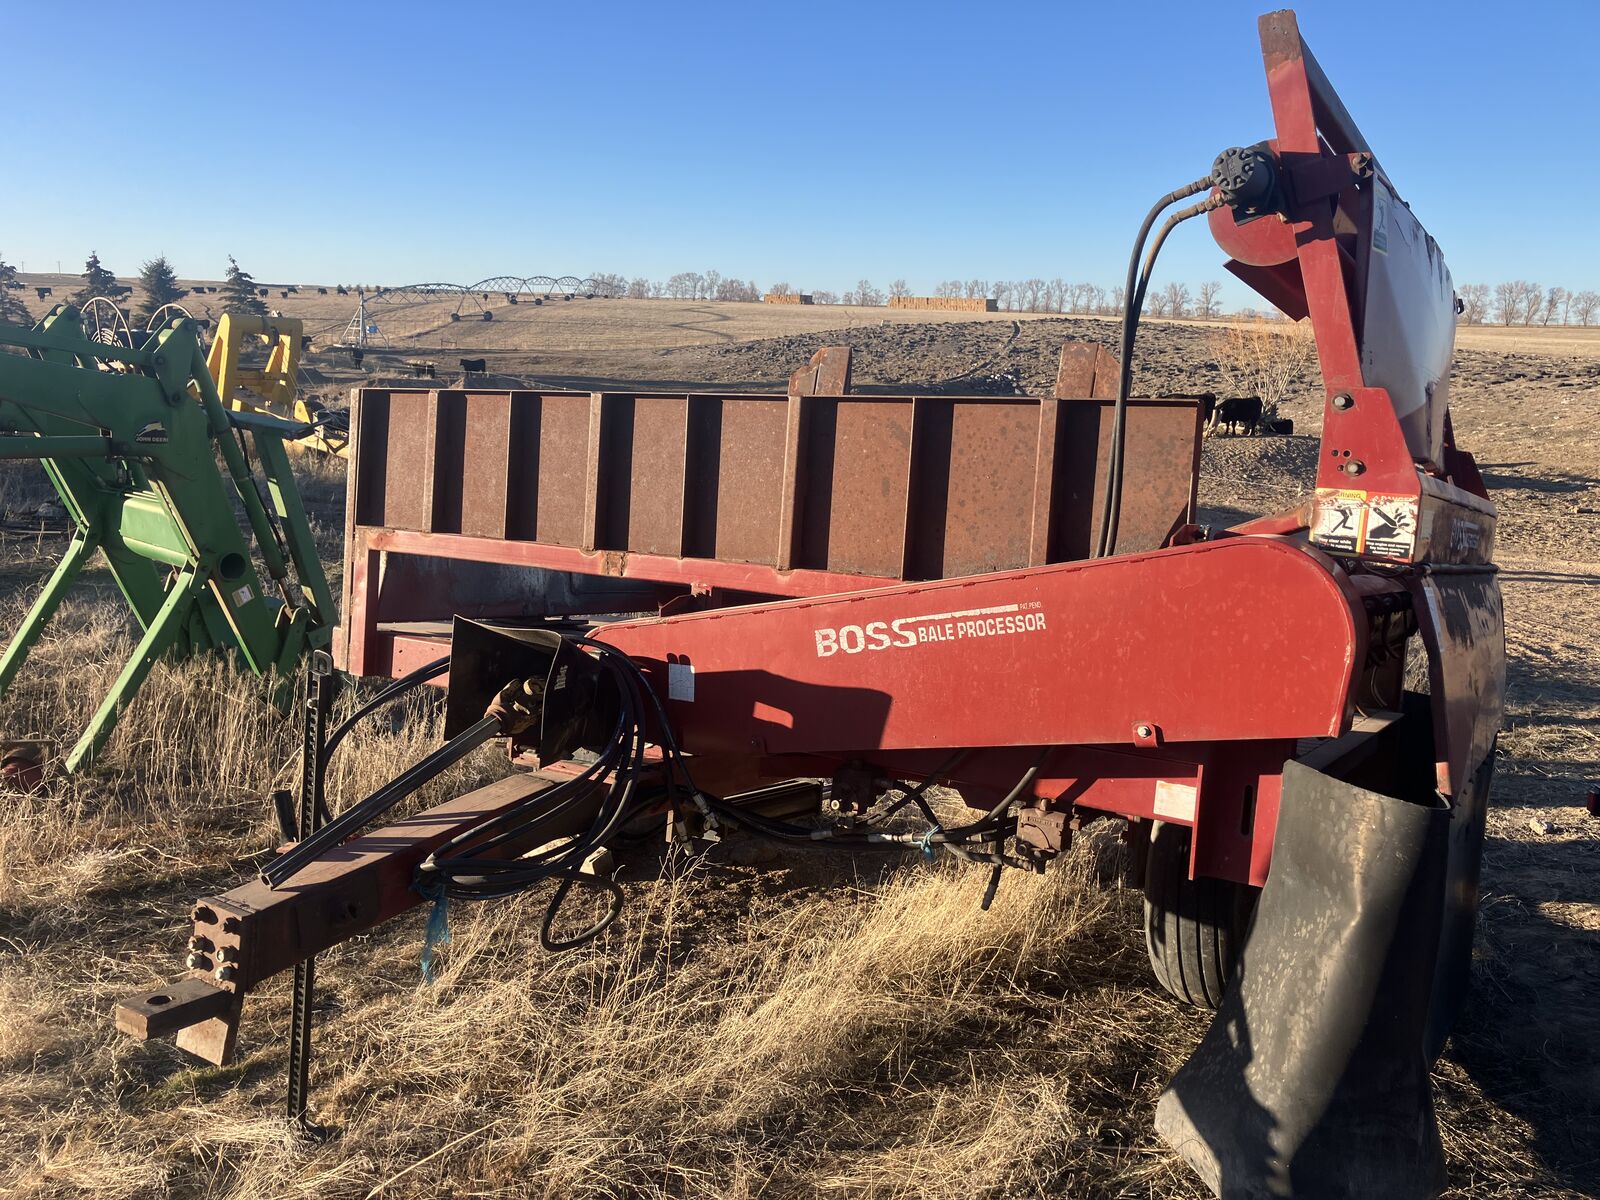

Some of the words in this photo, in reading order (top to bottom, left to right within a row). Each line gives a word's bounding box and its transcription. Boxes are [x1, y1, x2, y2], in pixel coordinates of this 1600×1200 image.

[814, 618, 918, 657] BOSS
[918, 624, 954, 643] BALE
[957, 613, 1047, 640] PROCESSOR
